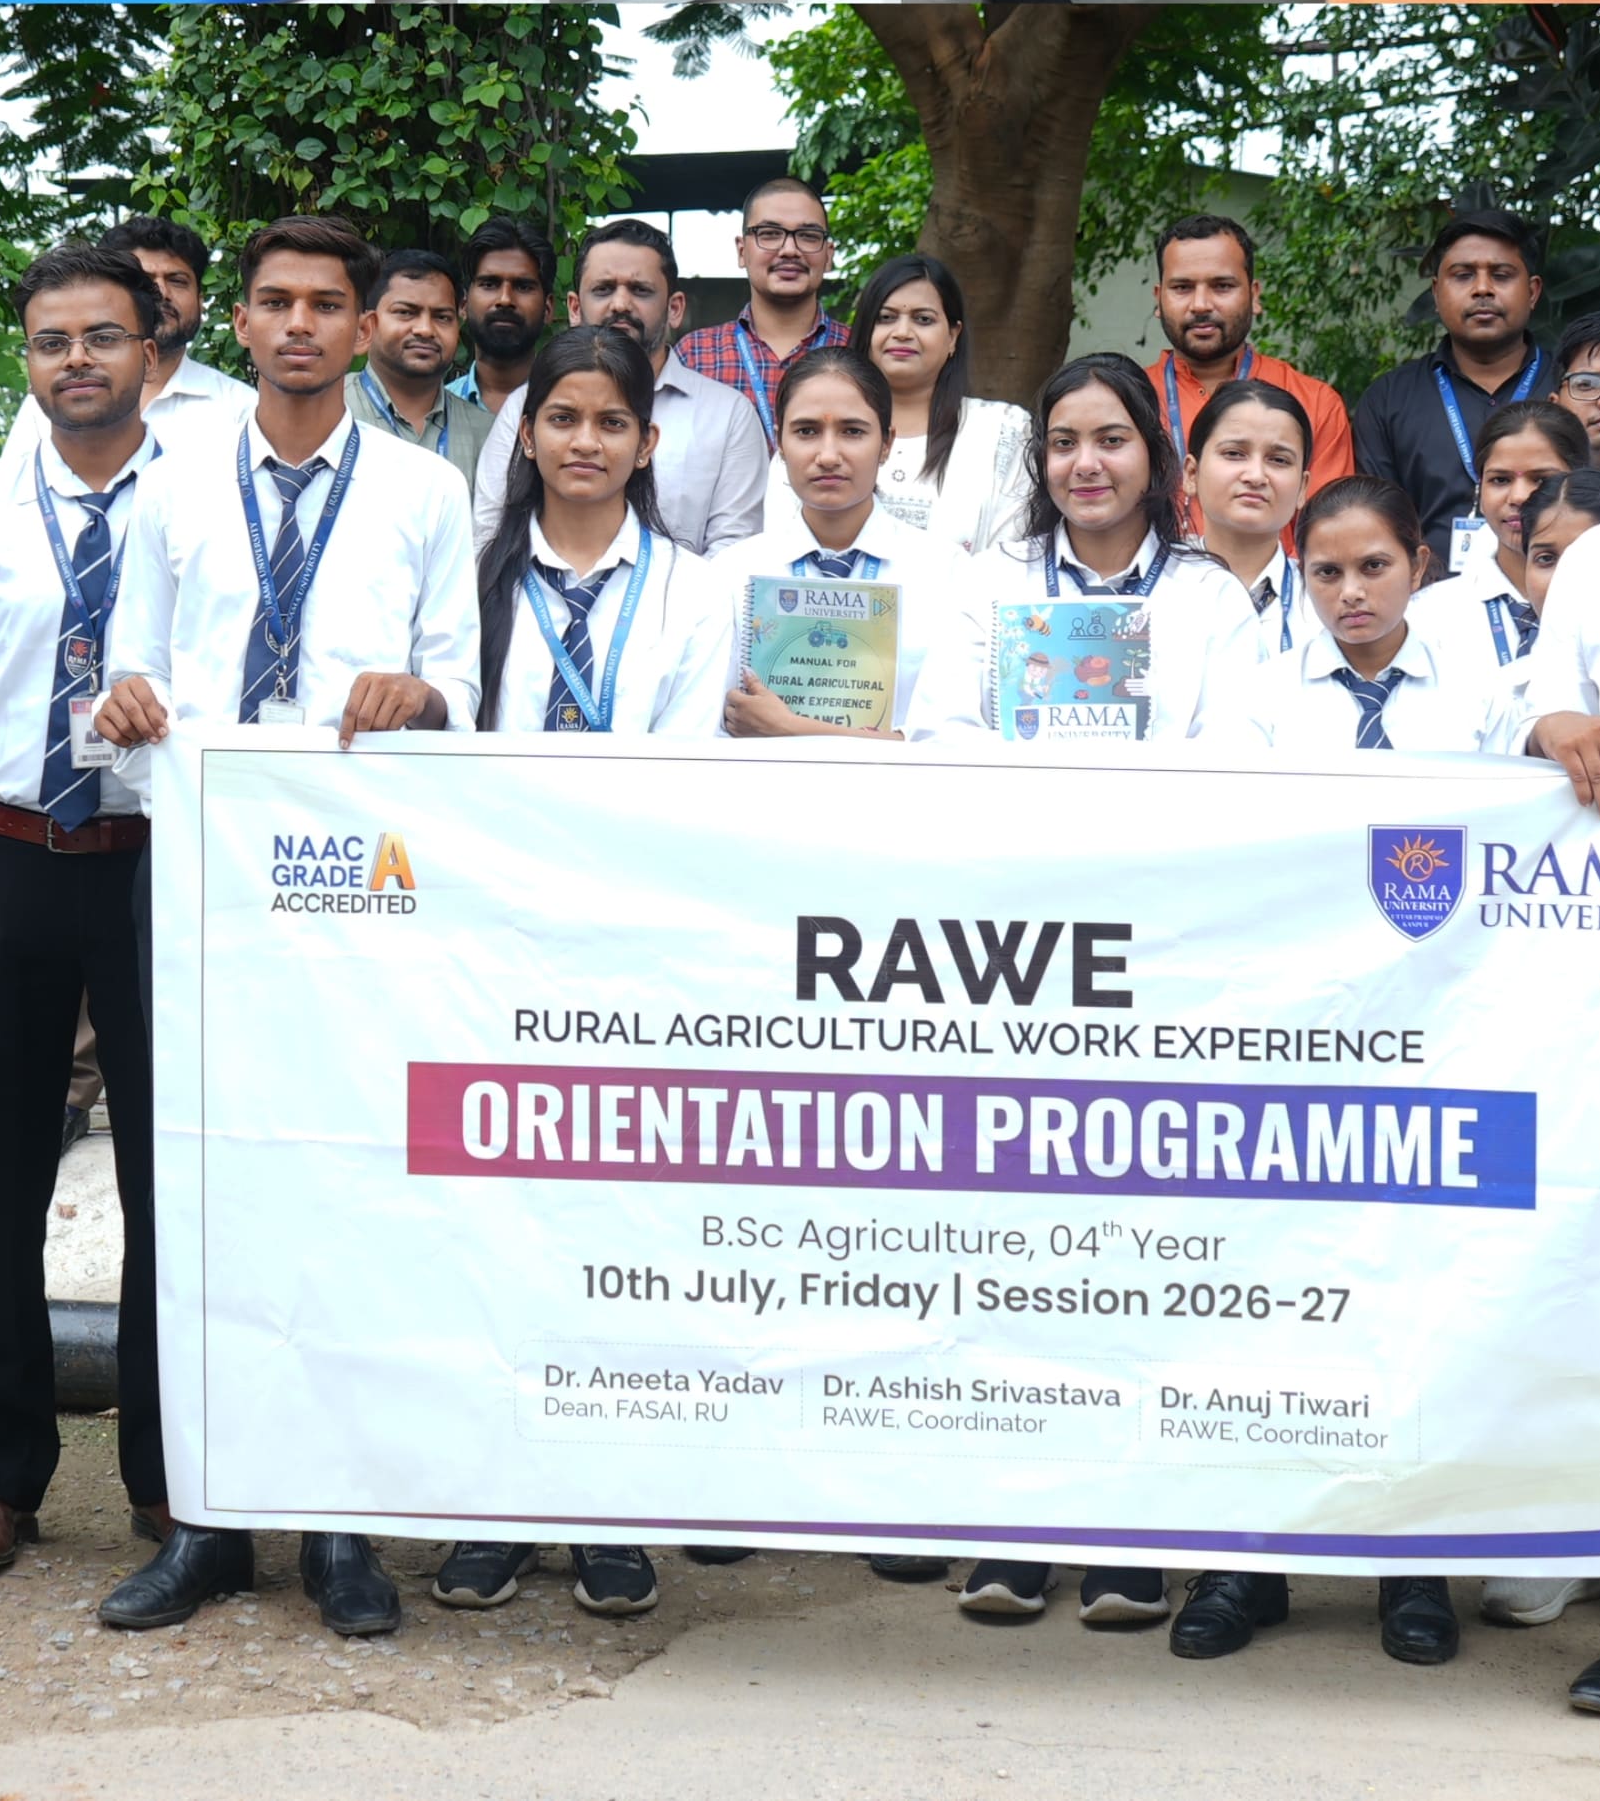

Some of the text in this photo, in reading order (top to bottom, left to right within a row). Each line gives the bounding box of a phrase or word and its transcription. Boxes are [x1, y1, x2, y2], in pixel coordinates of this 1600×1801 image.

[1447, 405, 1471, 463] RAMA UNIVERSITY
[238, 460, 249, 485] RAMA
[328, 432, 359, 506] RAMA UNIVERSITY
[54, 542, 77, 597] RAMA UNIVERSITY
[248, 521, 273, 605] RAMA UNIVERSITY
[297, 540, 321, 595] UNIVERSITY
[621, 549, 649, 617] RAMA UNIVERSITY
[805, 589, 865, 608] RAMA
[1138, 573, 1154, 595] RAMA
[537, 607, 551, 628] RAMA
[804, 607, 865, 619] UNIVERSITY
[601, 646, 618, 699] UNIVERSITY
[790, 656, 857, 668] MANUAL FOR
[560, 655, 588, 702] UNIVERSITY
[768, 675, 884, 691] RURAL AGRICULTURAL
[809, 697, 873, 710] EXPERIENCE
[1048, 706, 1131, 727] RAMA
[273, 835, 364, 861] NAAC
[366, 832, 416, 891] A
[272, 864, 363, 888] GRADE
[1384, 882, 1452, 901] RAMA
[271, 892, 417, 914] ACCREDITED
[1383, 901, 1452, 912] UNIVERSITY
[796, 915, 1133, 1008] RAWE
[515, 1009, 1424, 1063] RURAL AGRICULTURAL WORK EXPERIENCE
[460, 1079, 1479, 1189] ORIENTATION PROGRAMME
[702, 1215, 784, 1248] B.Sc
[798, 1219, 1036, 1262] Agriculture,
[1132, 1228, 1226, 1261] Year
[583, 1265, 670, 1301] 10th
[684, 1269, 786, 1316] July,
[801, 1271, 939, 1320] Friday
[977, 1278, 1149, 1316] Session
[1163, 1283, 1350, 1323] 2026-27
[543, 1364, 784, 1395] Dr. Aneeta Yadav
[824, 1375, 1121, 1407] Dr. Ashish Srivastava
[543, 1396, 728, 1423] Dean, FASAI, RU
[1160, 1386, 1370, 1418] Dr. Anuj Tiwari
[823, 1406, 1047, 1433] RAWE, Coordinator
[1160, 1418, 1389, 1449] RAWE, Coordinator
